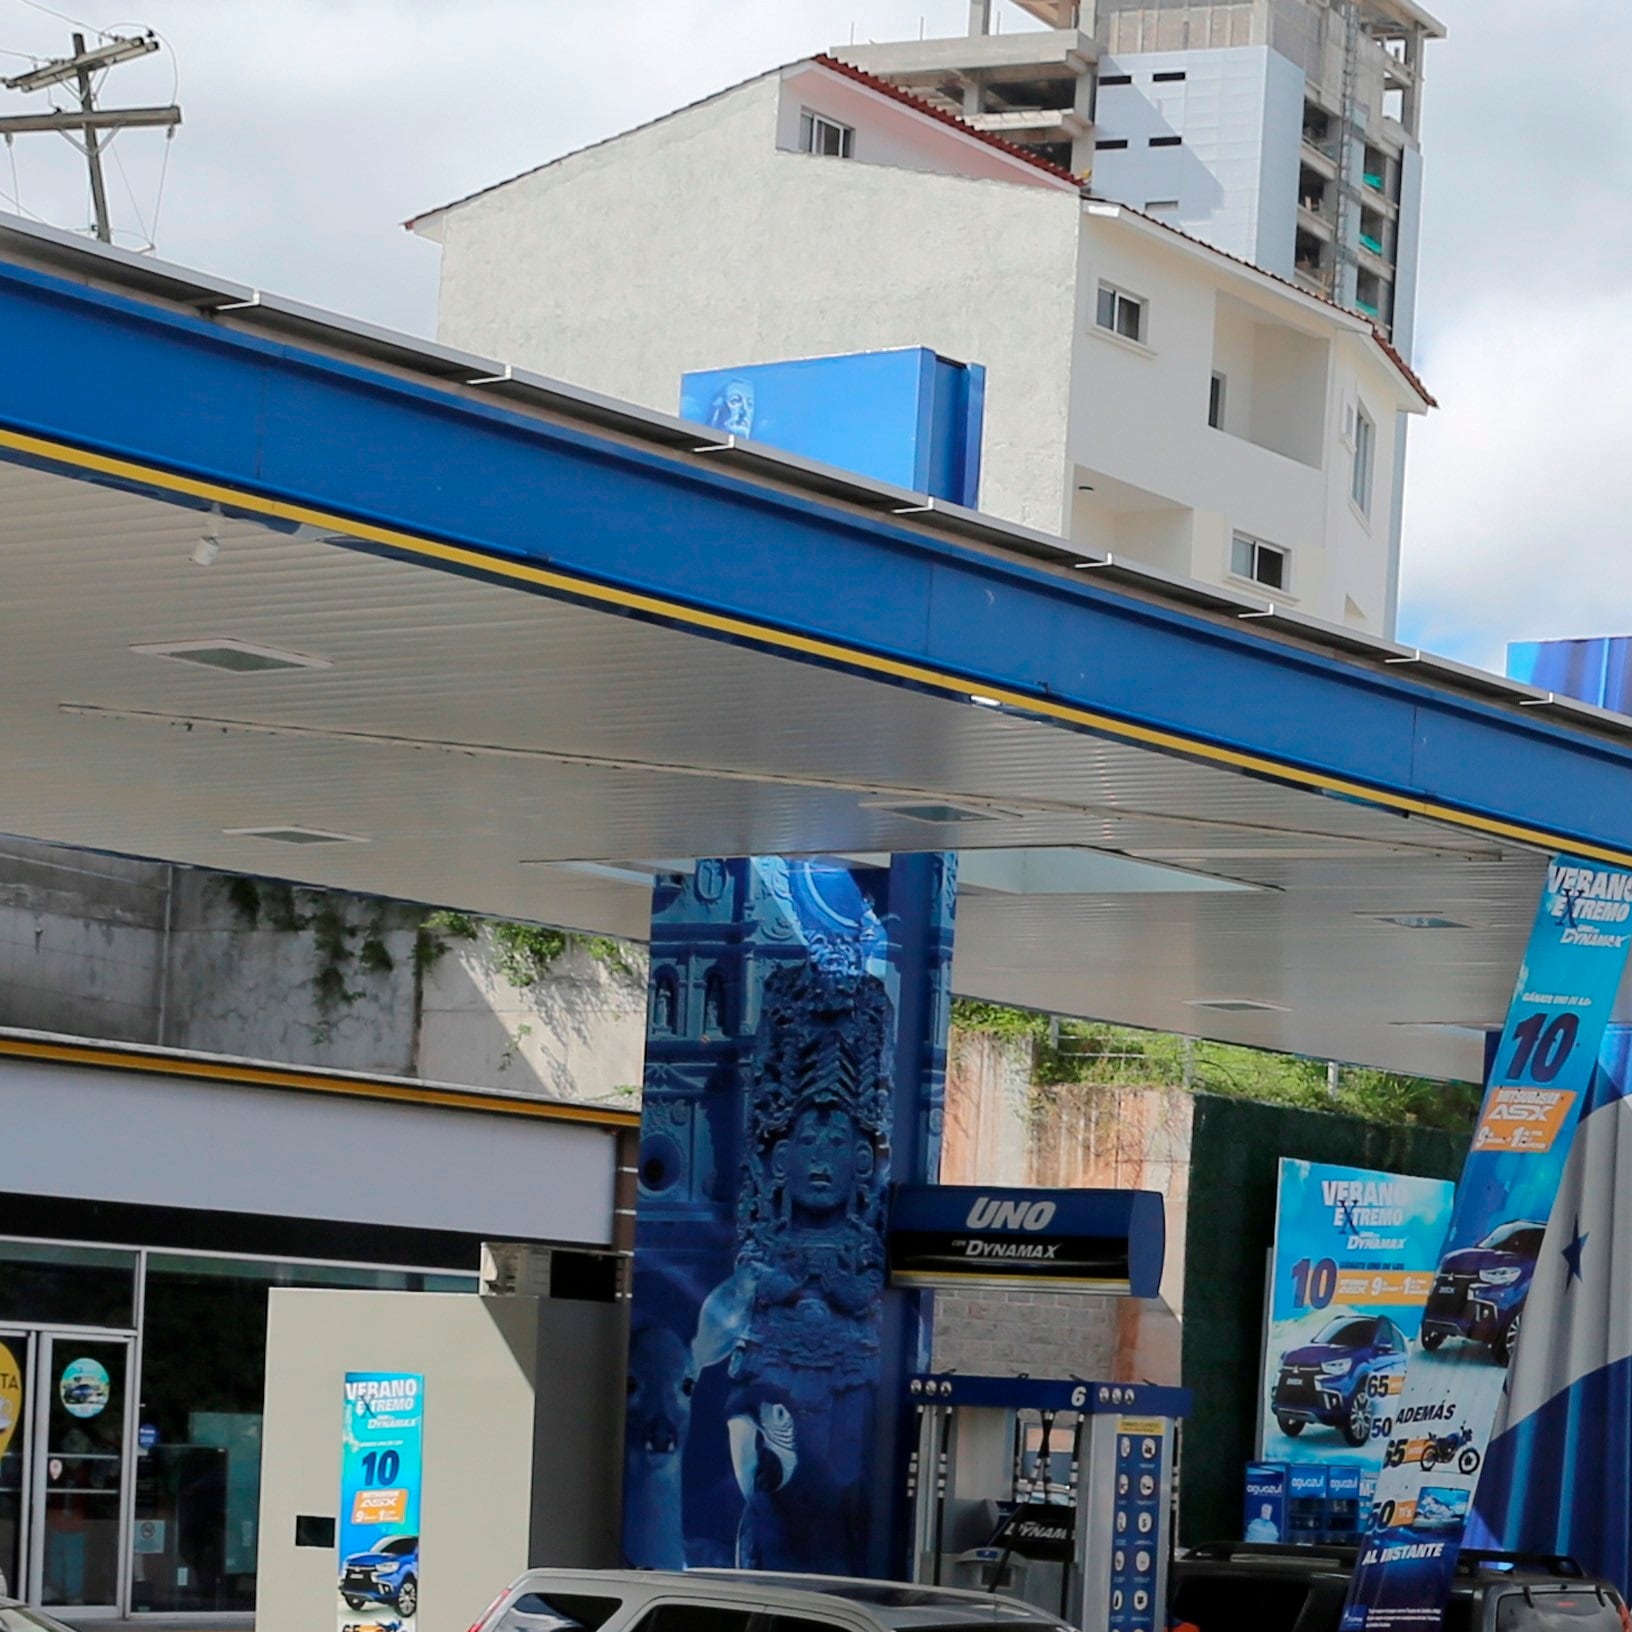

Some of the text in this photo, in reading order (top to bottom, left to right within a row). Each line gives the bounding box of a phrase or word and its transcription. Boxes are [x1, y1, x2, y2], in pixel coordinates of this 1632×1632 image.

[1505, 1012, 1580, 1083] 10
[1489, 1103, 1554, 1122] ASX
[966, 1197, 1057, 1231] UNO
[965, 1240, 1060, 1259] DYNAMAX
[1291, 1256, 1338, 1309] 10
[345, 1378, 418, 1400] VERANO
[1070, 1386, 1087, 1407] 6
[1367, 1375, 1389, 1399] 65
[1395, 1399, 1457, 1424] ADEMÁS
[1370, 1416, 1393, 1439] 50
[361, 1449, 400, 1487] 10
[1362, 1549, 1378, 1566] AL
